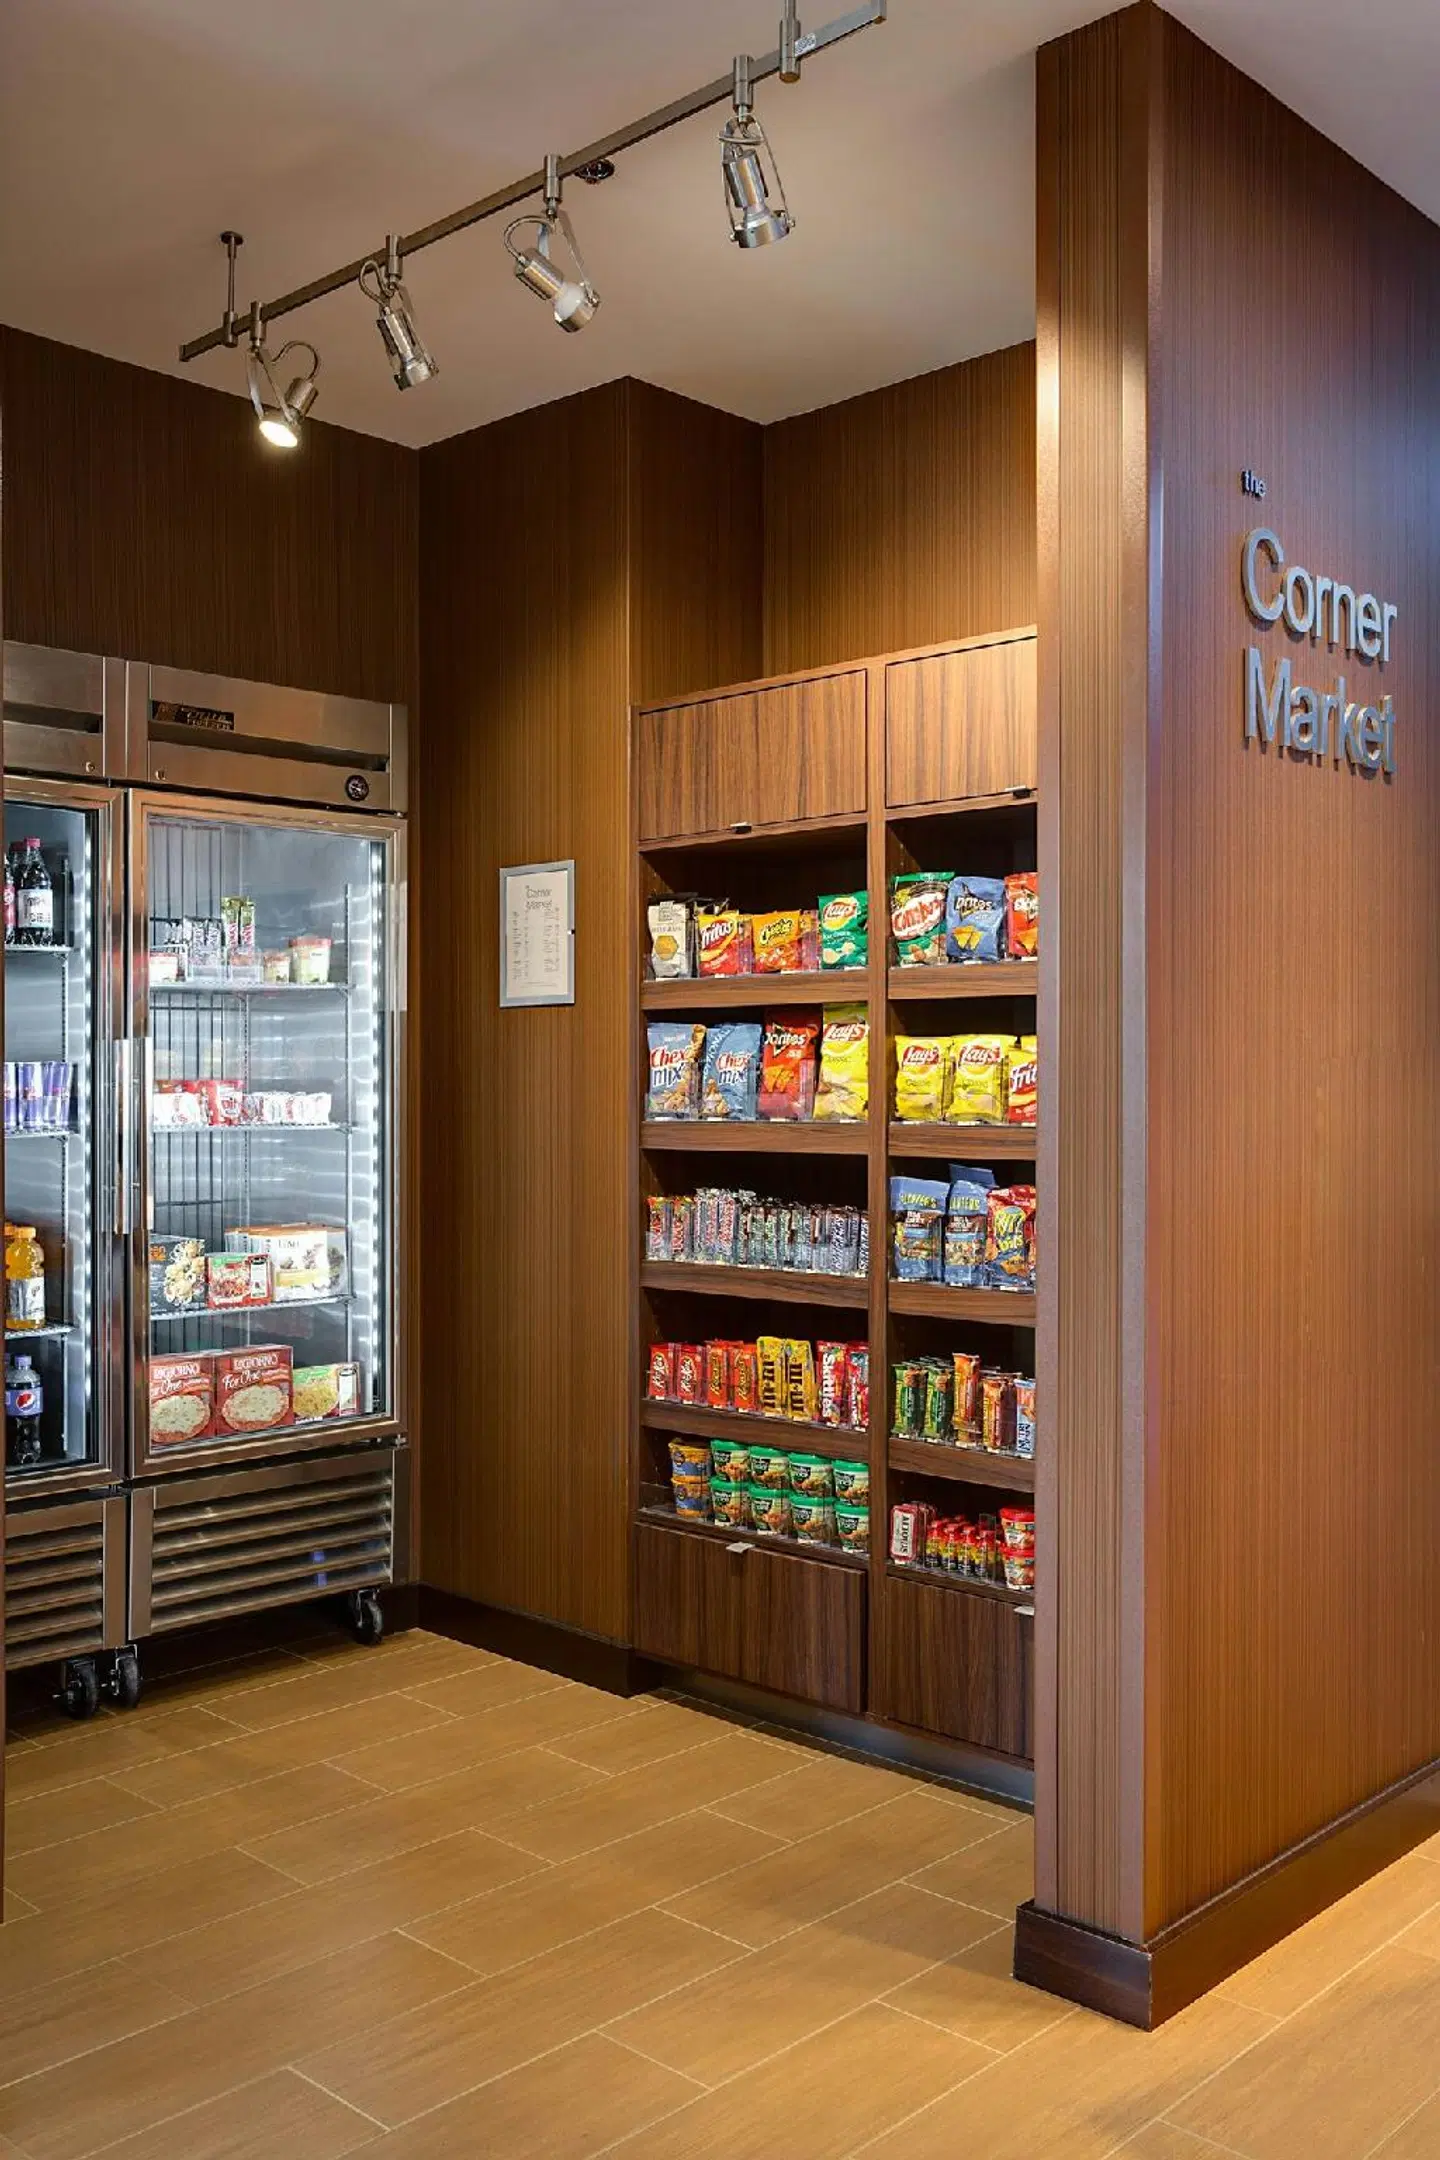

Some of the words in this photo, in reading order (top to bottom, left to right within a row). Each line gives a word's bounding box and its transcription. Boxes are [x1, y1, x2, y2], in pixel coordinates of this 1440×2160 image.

[1242, 469, 1267, 498] the
[1241, 526, 1397, 663] Corner
[1244, 645, 1396, 775] Market
